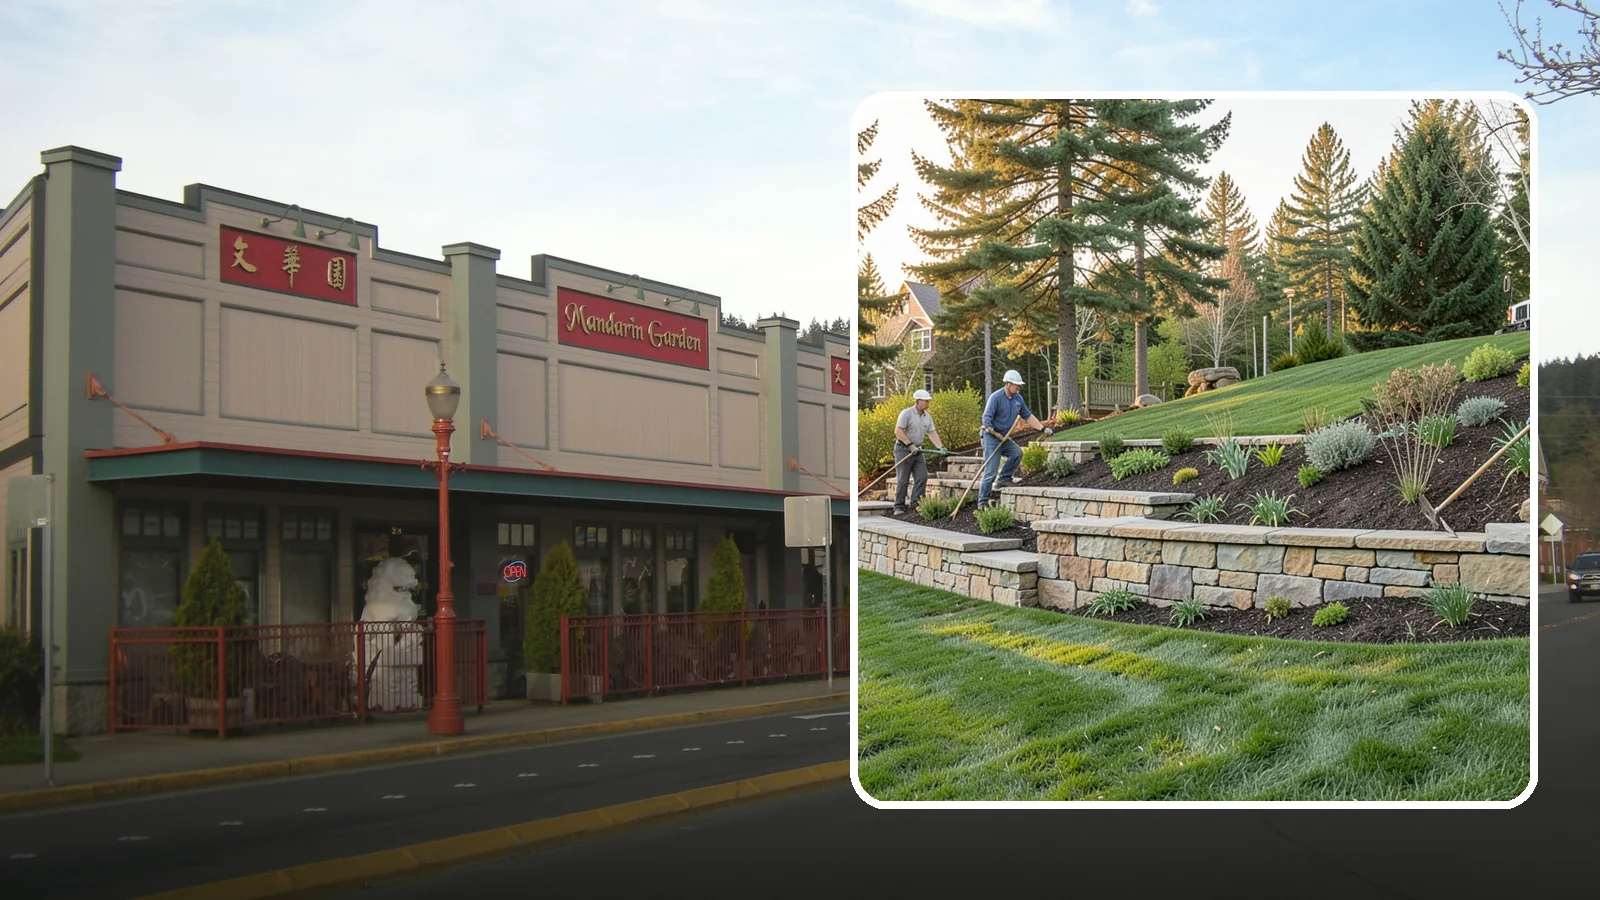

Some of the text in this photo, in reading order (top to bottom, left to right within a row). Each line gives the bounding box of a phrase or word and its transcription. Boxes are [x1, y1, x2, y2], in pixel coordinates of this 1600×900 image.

[231, 236, 346, 291] 文華園
[564, 302, 701, 352] Mandarin Garden
[503, 565, 527, 578] OPEN
